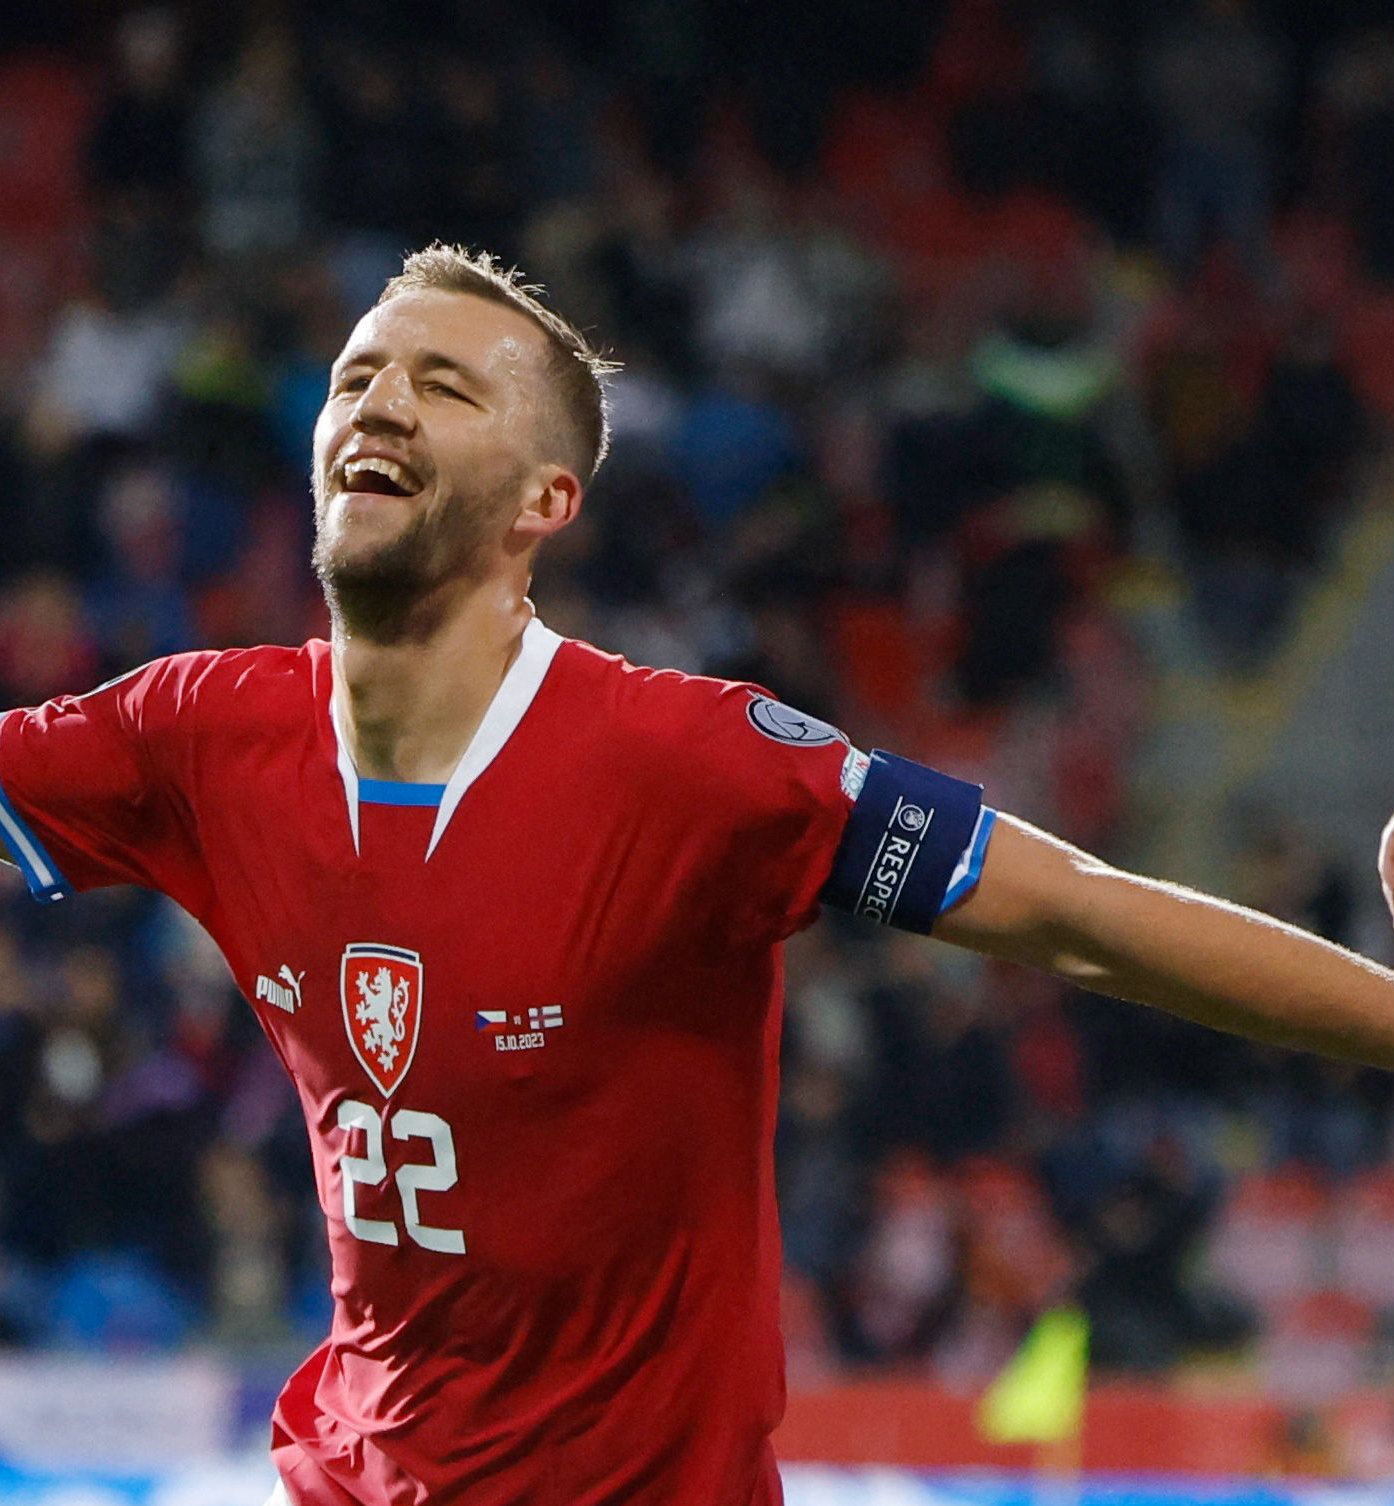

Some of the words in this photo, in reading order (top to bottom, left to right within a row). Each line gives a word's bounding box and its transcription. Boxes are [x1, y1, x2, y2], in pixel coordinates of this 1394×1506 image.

[863, 835, 912, 925] RESPEC
[255, 974, 295, 1015] PUMA
[494, 1032, 545, 1052] 15.10.2023
[337, 1100, 466, 1255] 22
